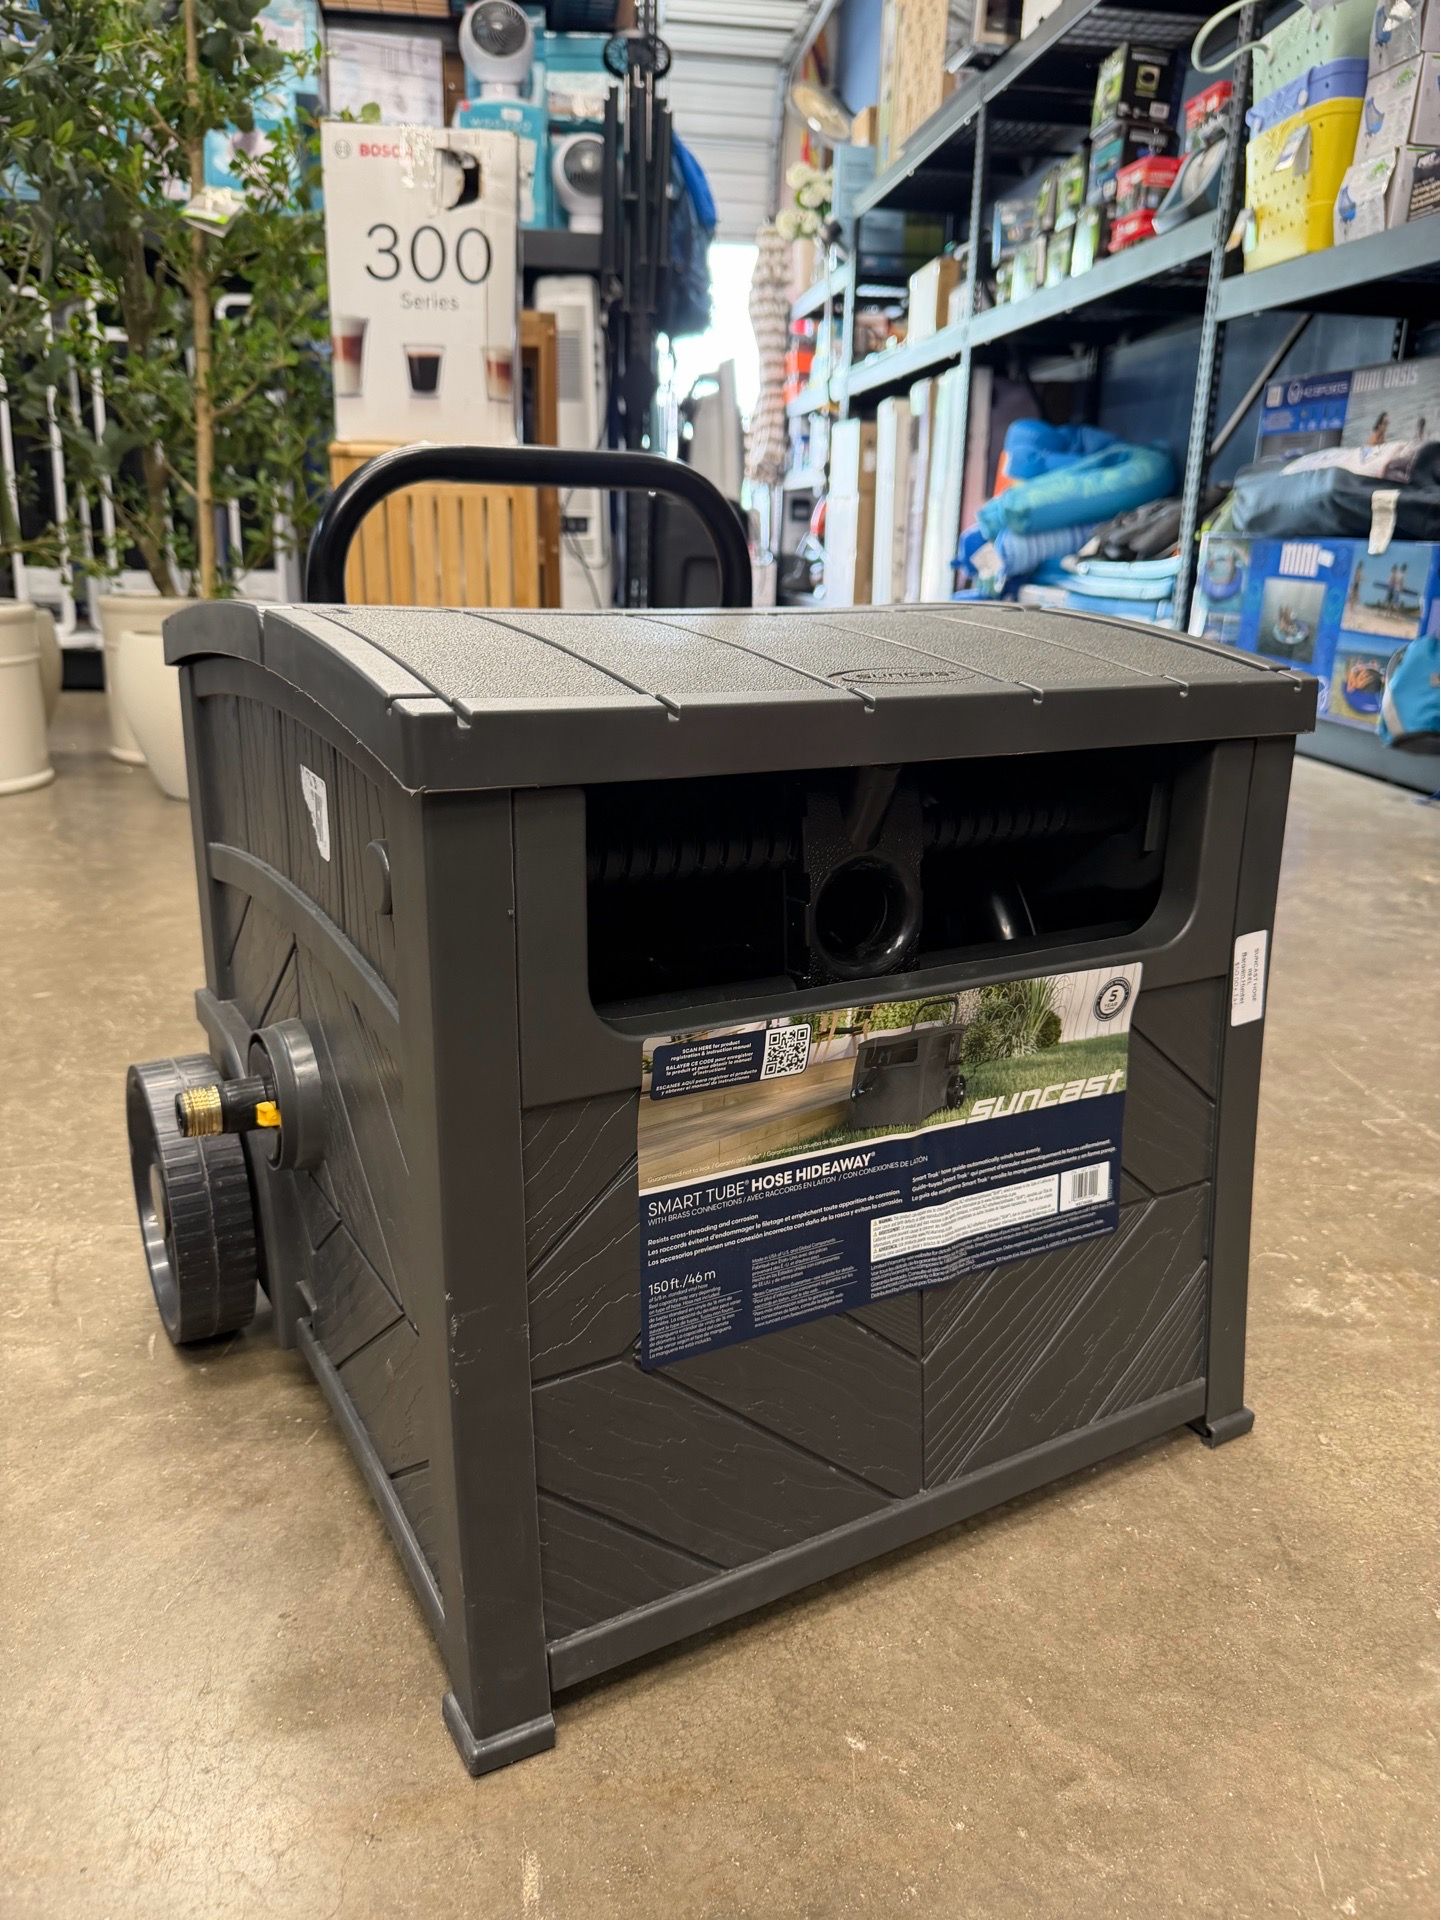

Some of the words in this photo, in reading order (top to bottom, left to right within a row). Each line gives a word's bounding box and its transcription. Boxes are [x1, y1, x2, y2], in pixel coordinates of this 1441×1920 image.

[365, 223, 492, 284] 300
[400, 293, 459, 311] Series
[1108, 989, 1119, 1002] 5
[671, 1053, 700, 1062] registration
[706, 1047, 732, 1055] instruction
[721, 1040, 740, 1048] product
[666, 1063, 690, 1071] BALAYER
[735, 1069, 758, 1077] producto
[952, 1165, 966, 1173] guide
[967, 1156, 1000, 1169] automatically
[912, 1180, 942, 1192] Guide-tuyau
[979, 1166, 996, 1175] permet
[939, 1185, 961, 1195] manguera
[648, 1217, 666, 1226] WITH
[668, 1211, 690, 1221] BRASS
[692, 1198, 742, 1215] CONNECTIONS
[746, 1193, 764, 1202] AVEC
[765, 1184, 802, 1198] RACCORDS
[813, 1176, 836, 1187] LAITON
[843, 1171, 858, 1180] CON
[859, 1162, 898, 1176] CONEXIONES
[900, 1160, 908, 1168] DE
[910, 1156, 928, 1165] LATÓN
[648, 1192, 702, 1217] SMART
[751, 1171, 792, 1192] HOSE
[648, 1236, 669, 1246] Resists
[670, 1224, 718, 1241] cross-threading
[731, 1214, 758, 1225] corrosion
[660, 1242, 687, 1253] raccords
[688, 1236, 708, 1245] évitent
[710, 1225, 754, 1241] d'endommager
[762, 1218, 784, 1228] filetage
[792, 1207, 822, 1220] empêchent
[824, 1204, 838, 1212] toute
[839, 1197, 866, 1209] apparition
[875, 1189, 900, 1200] corrosion
[660, 1251, 693, 1263] accesorios
[694, 1243, 724, 1255] previenen
[737, 1233, 762, 1244] conexión
[764, 1226, 793, 1237] incorrecta
[855, 1206, 871, 1214] evitan
[878, 1198, 903, 1208] corrosión
[648, 1281, 668, 1296] 150
[670, 1272, 702, 1291] ft./46
[705, 1270, 716, 1281] m
